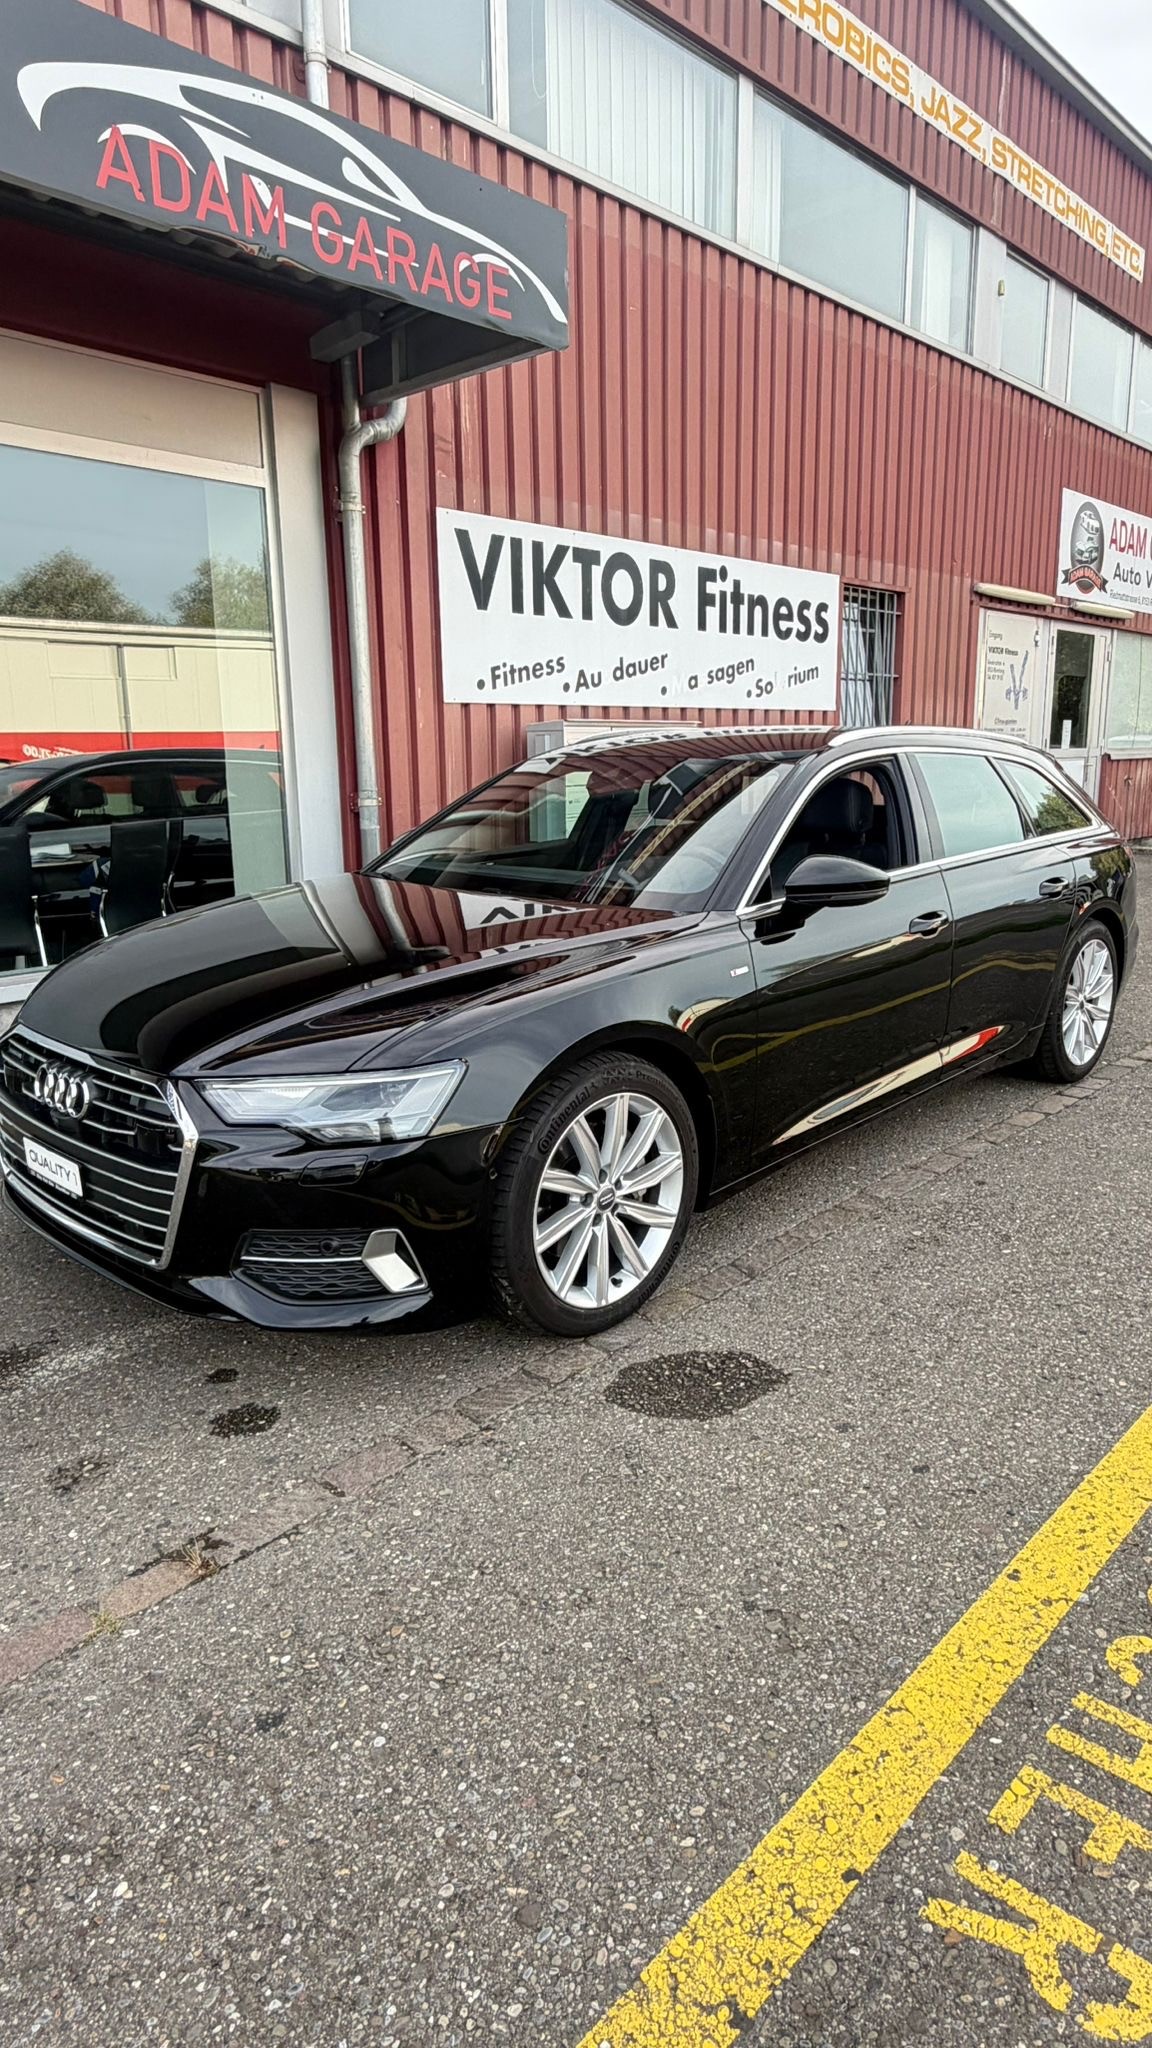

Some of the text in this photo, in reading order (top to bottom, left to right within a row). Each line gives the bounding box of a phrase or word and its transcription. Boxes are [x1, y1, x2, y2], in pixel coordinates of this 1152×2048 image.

[778, 0, 914, 107] ROBICS,
[921, 86, 987, 164] JAZZ,
[96, 124, 512, 320] ADAM GARAGE
[1109, 517, 1148, 560] ADAM
[453, 527, 830, 644] VIKTOR Fitness
[1113, 562, 1141, 586] Auto
[490, 655, 565, 690] Fitness
[29, 1149, 71, 1182] QUALITY
